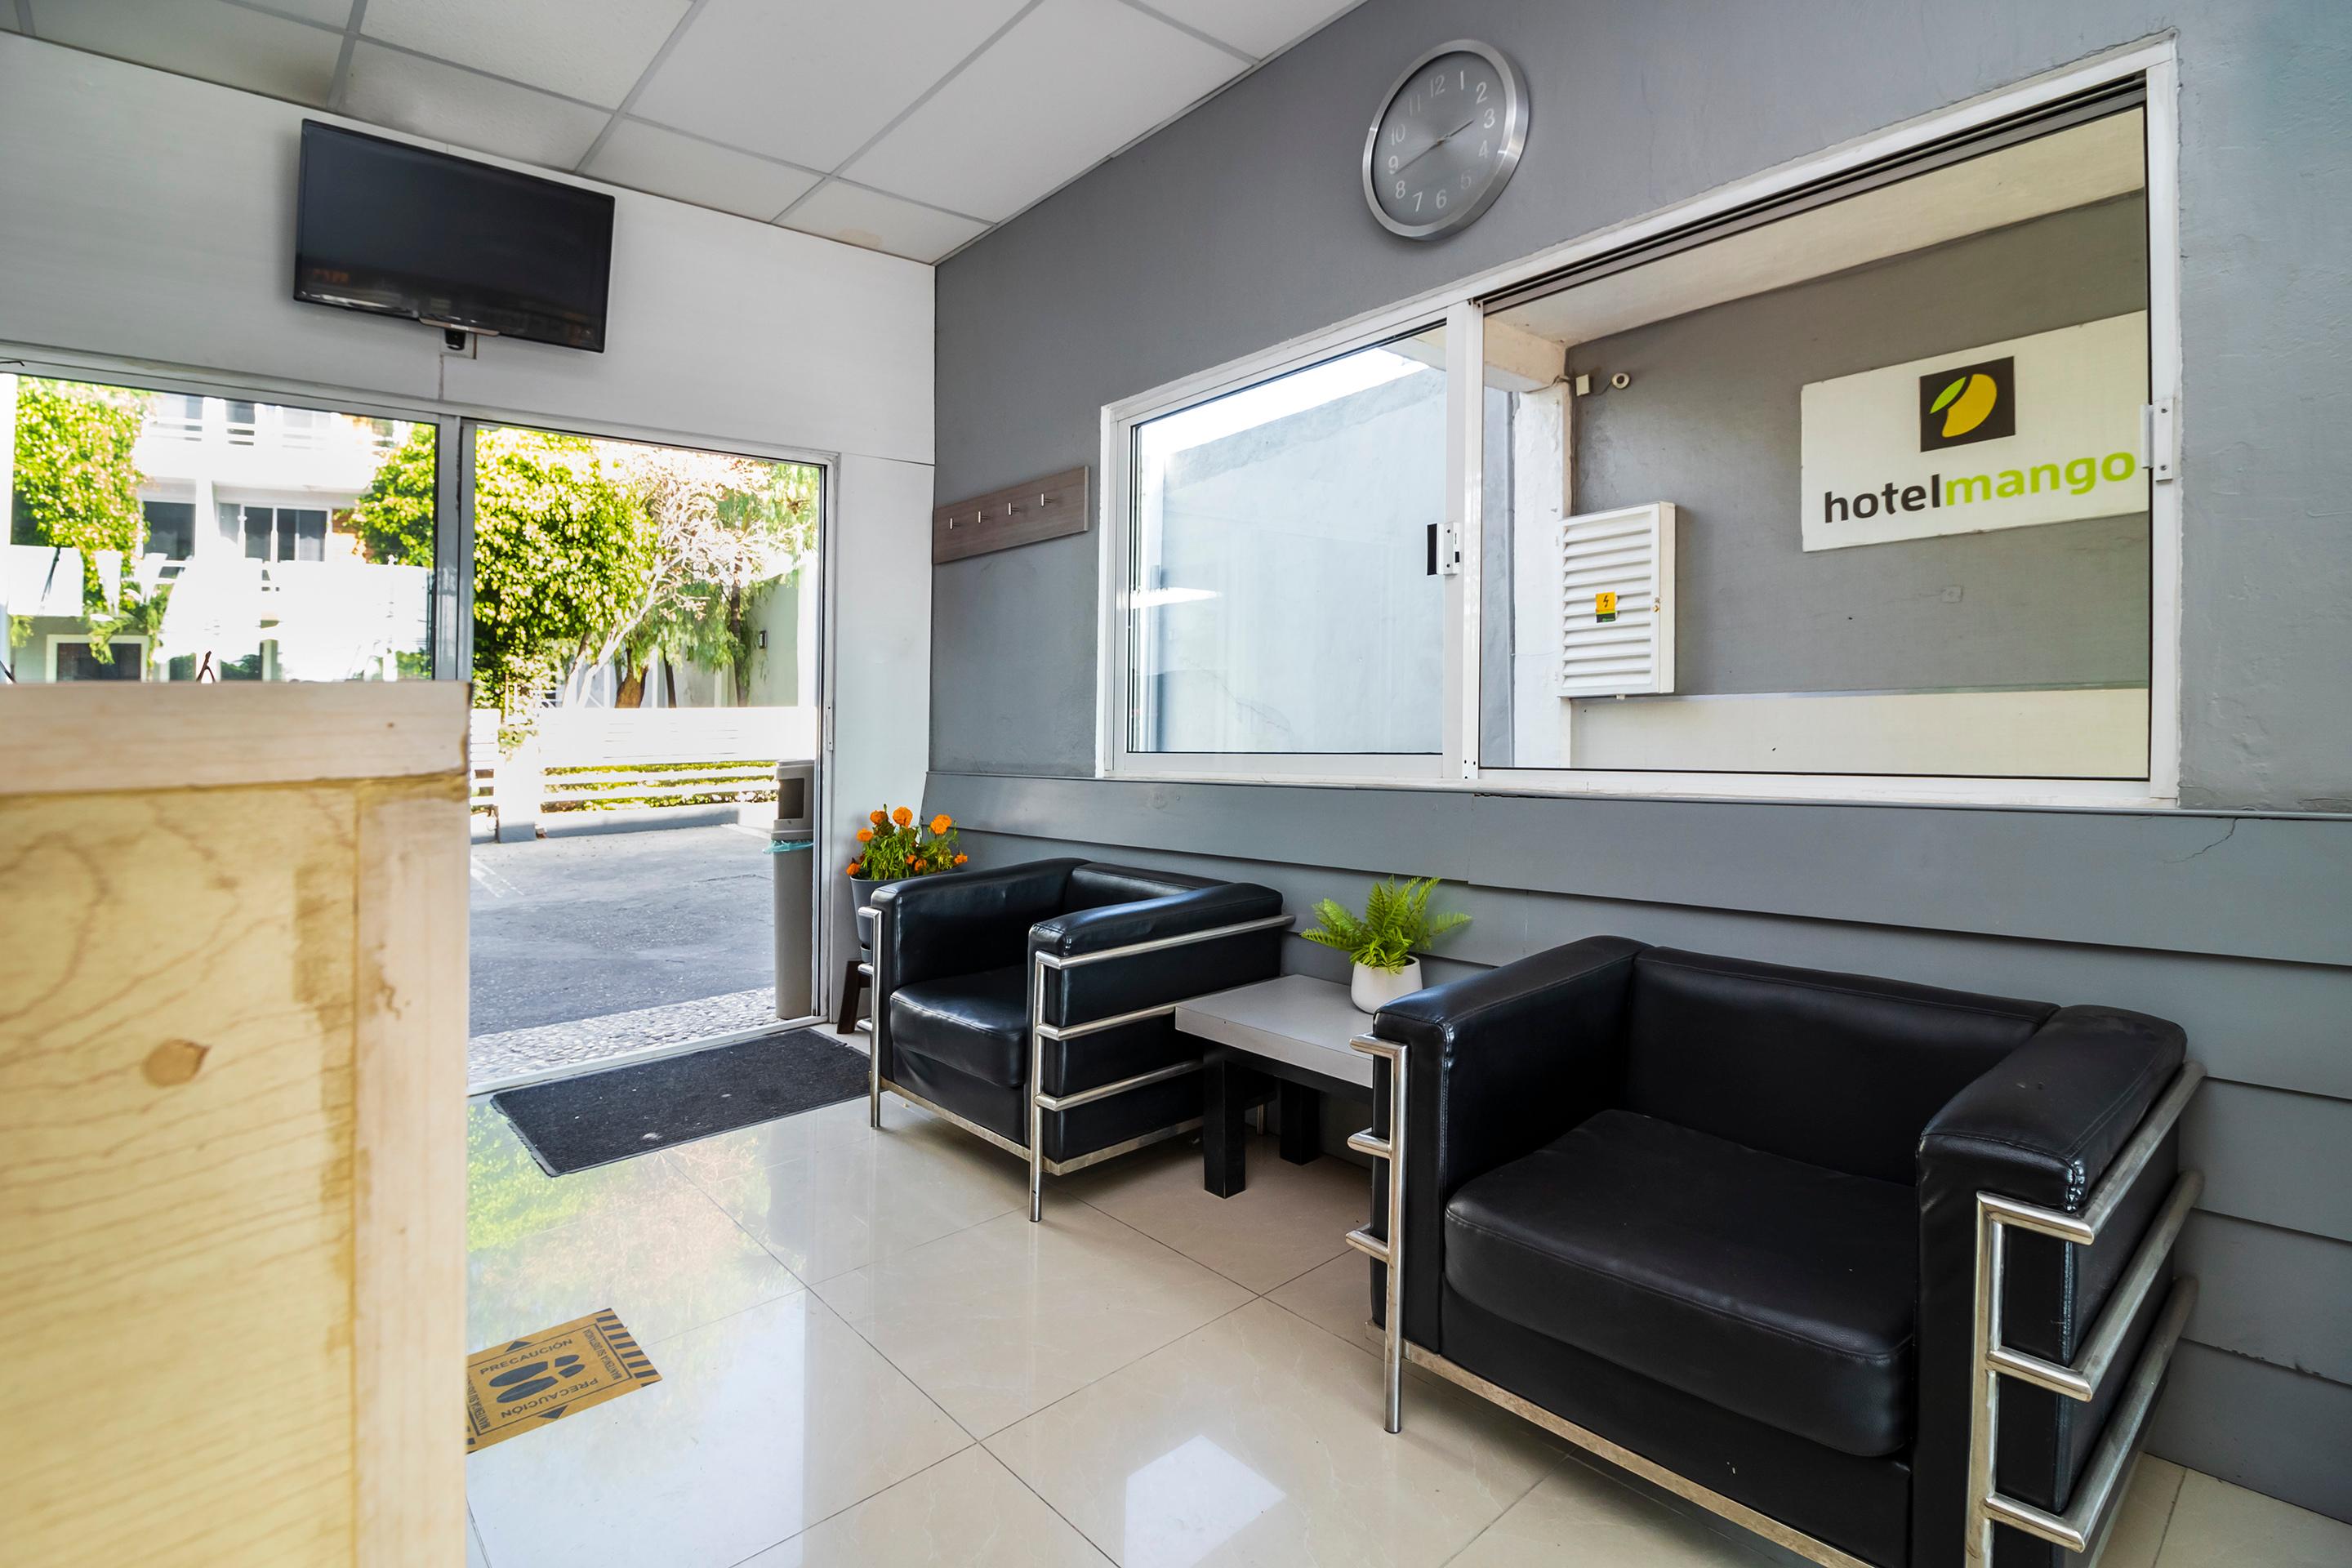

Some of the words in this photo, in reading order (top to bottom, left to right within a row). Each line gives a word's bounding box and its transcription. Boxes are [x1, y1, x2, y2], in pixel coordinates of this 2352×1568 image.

[1429, 74, 1446, 98] 12
[1459, 70, 1465, 91] 1
[1476, 82, 1487, 104] 2
[1409, 94, 1421, 117] 11
[1484, 109, 1495, 128] 3
[1391, 123, 1405, 145] 10
[1478, 140, 1488, 158] 4
[1388, 155, 1399, 175] 9
[1395, 180, 1405, 199] 8
[1436, 189, 1447, 209] 6
[1412, 192, 1423, 212] 7
[479, 1339, 572, 1375] PRECAUCIÓN
[501, 1377, 599, 1418] PRECAUCIÓN
